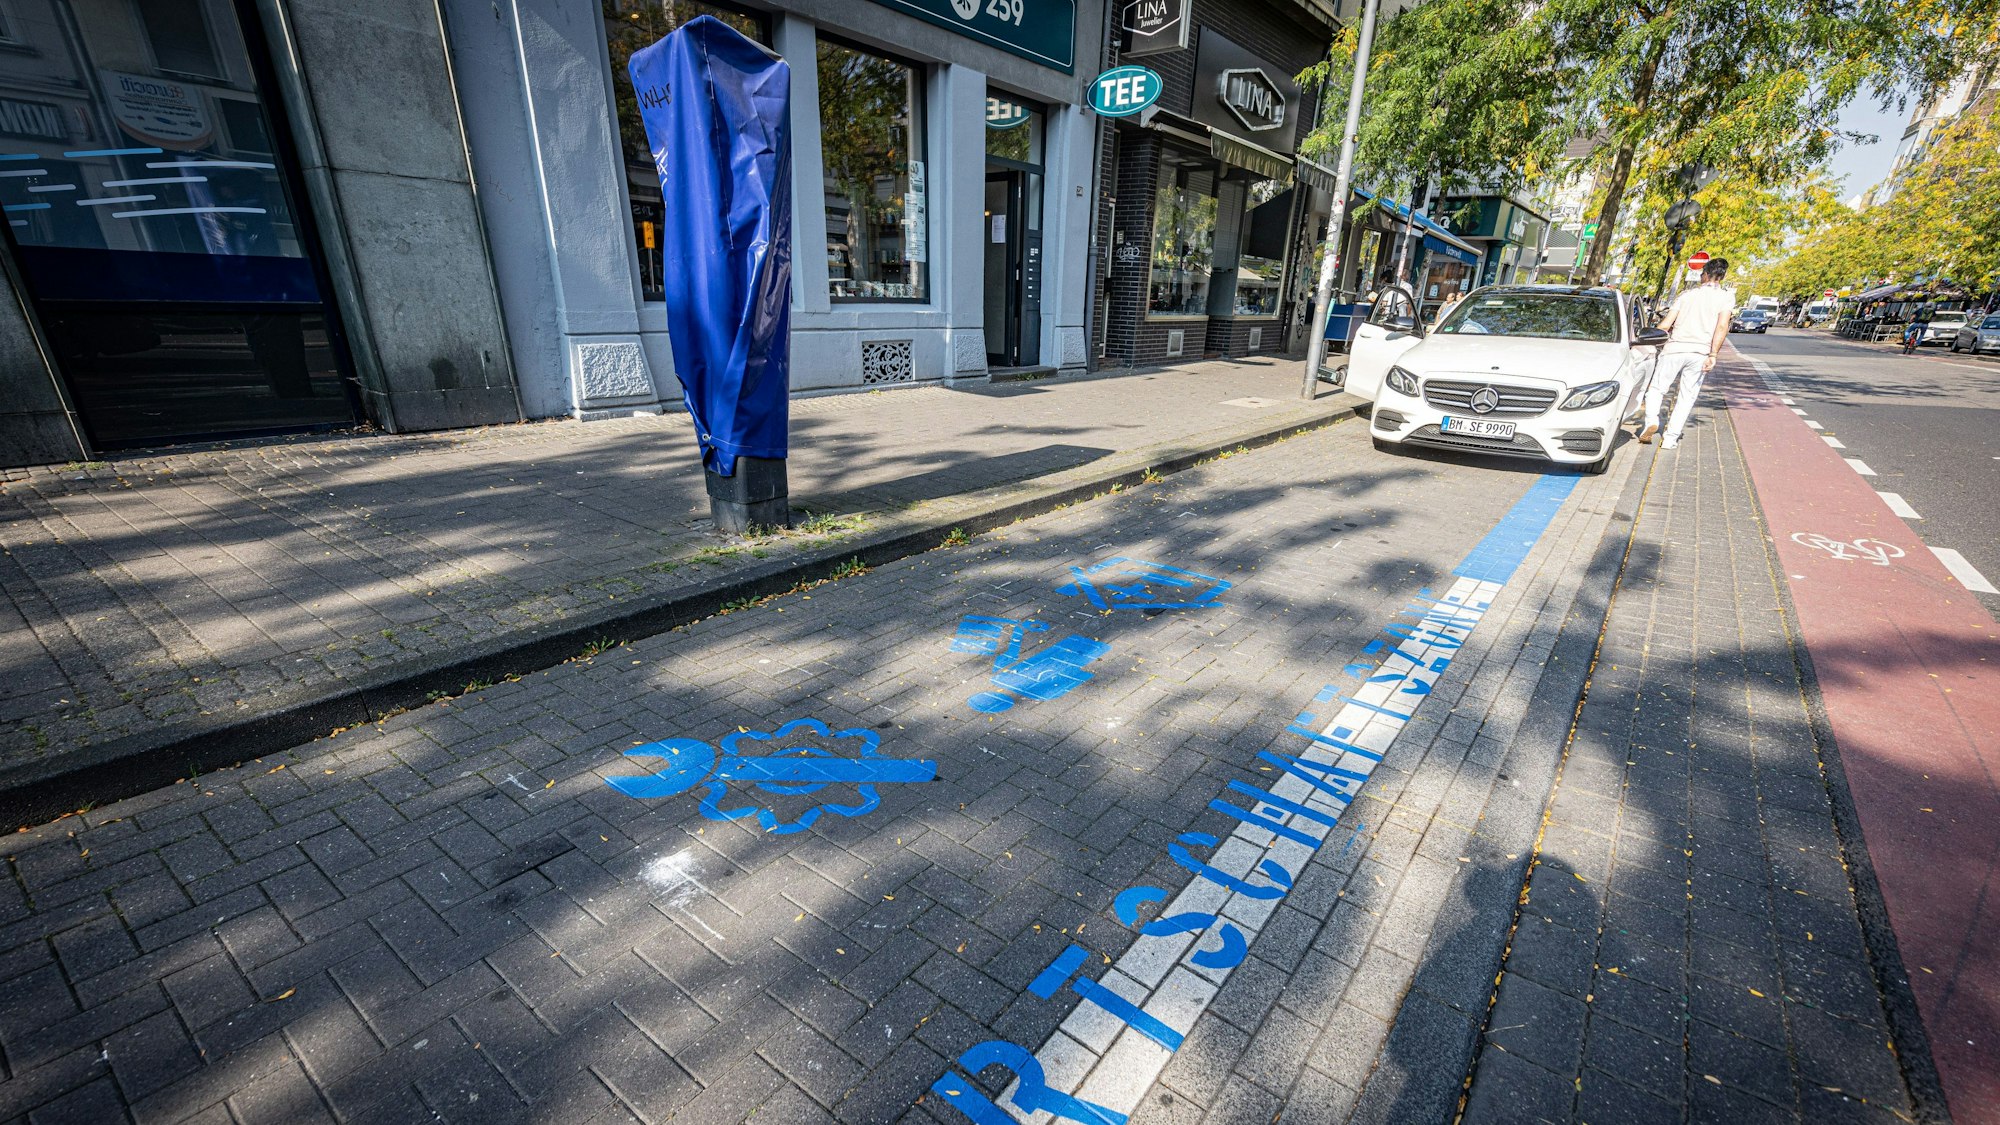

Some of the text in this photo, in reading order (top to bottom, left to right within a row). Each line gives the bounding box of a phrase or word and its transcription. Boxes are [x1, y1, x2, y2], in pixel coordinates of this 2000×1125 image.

[986, 0, 1024, 26] 259
[1137, 0, 1167, 19] LINA
[1141, 16, 1164, 28] Juwelier
[1100, 75, 1147, 107] TEE
[1235, 77, 1272, 120] LINA
[1449, 419, 1463, 430] BM
[1469, 421, 1484, 433] SE
[1485, 423, 1513, 436] 9990
